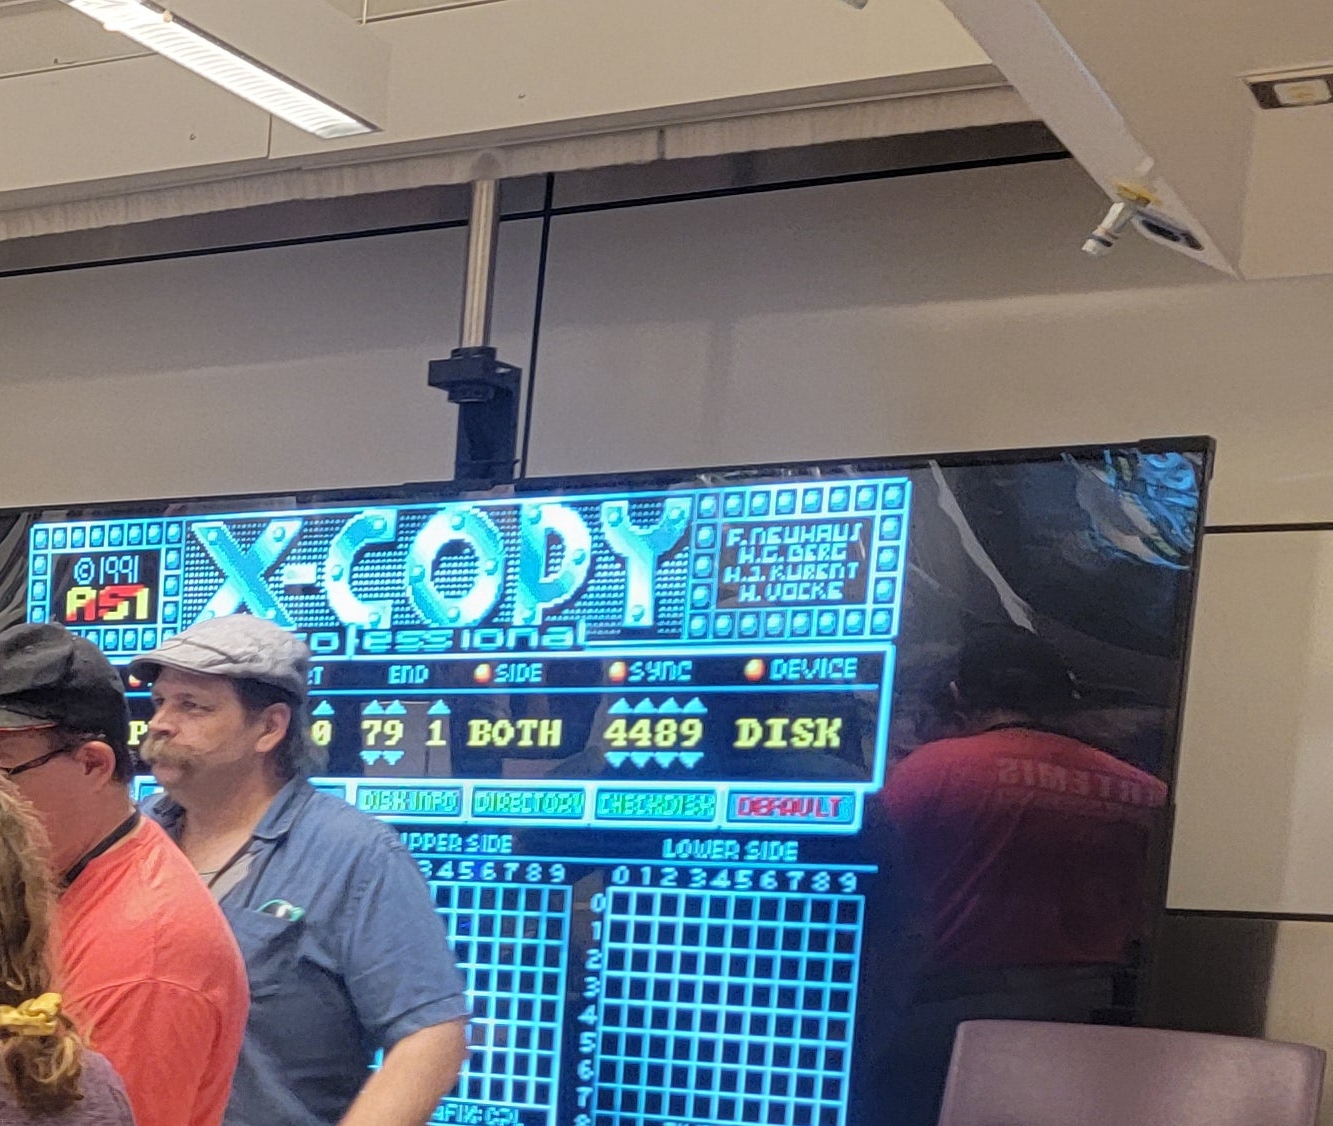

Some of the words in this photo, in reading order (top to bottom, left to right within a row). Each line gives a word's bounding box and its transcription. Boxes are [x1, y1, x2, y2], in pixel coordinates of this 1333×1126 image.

[190, 501, 692, 632] X-COPY
[294, 620, 588, 659] ofessional
[388, 664, 429, 685] END
[494, 662, 543, 684] SIDE
[628, 660, 693, 682] SYNC
[769, 657, 858, 681] DEVICE
[361, 719, 405, 746] 79
[425, 719, 448, 746] 1
[466, 718, 563, 747] BOTH
[603, 718, 703, 748] 4489
[733, 717, 843, 749] DISK
[473, 791, 585, 815] DIRECTORY
[736, 796, 844, 818] DEFAULT
[463, 834, 513, 854] SIDE
[662, 838, 740, 859] LOWER
[743, 840, 799, 861] SIDE
[611, 866, 630, 885] 0
[640, 866, 652, 886] 1
[660, 867, 678, 886] 2
[689, 868, 707, 888] 3
[709, 869, 731, 889] 4
[734, 870, 753, 890] 5
[759, 870, 778, 890] 6
[786, 871, 805, 891] 7
[811, 871, 830, 892] 8
[838, 872, 857, 893] 9
[590, 893, 606, 913] 0
[591, 921, 602, 941] 1
[585, 949, 602, 970] 2
[583, 976, 600, 998] 3
[577, 1004, 598, 1026] 4
[579, 1032, 597, 1053] 5
[577, 1059, 594, 1081] 6
[576, 1086, 593, 1107] 7
